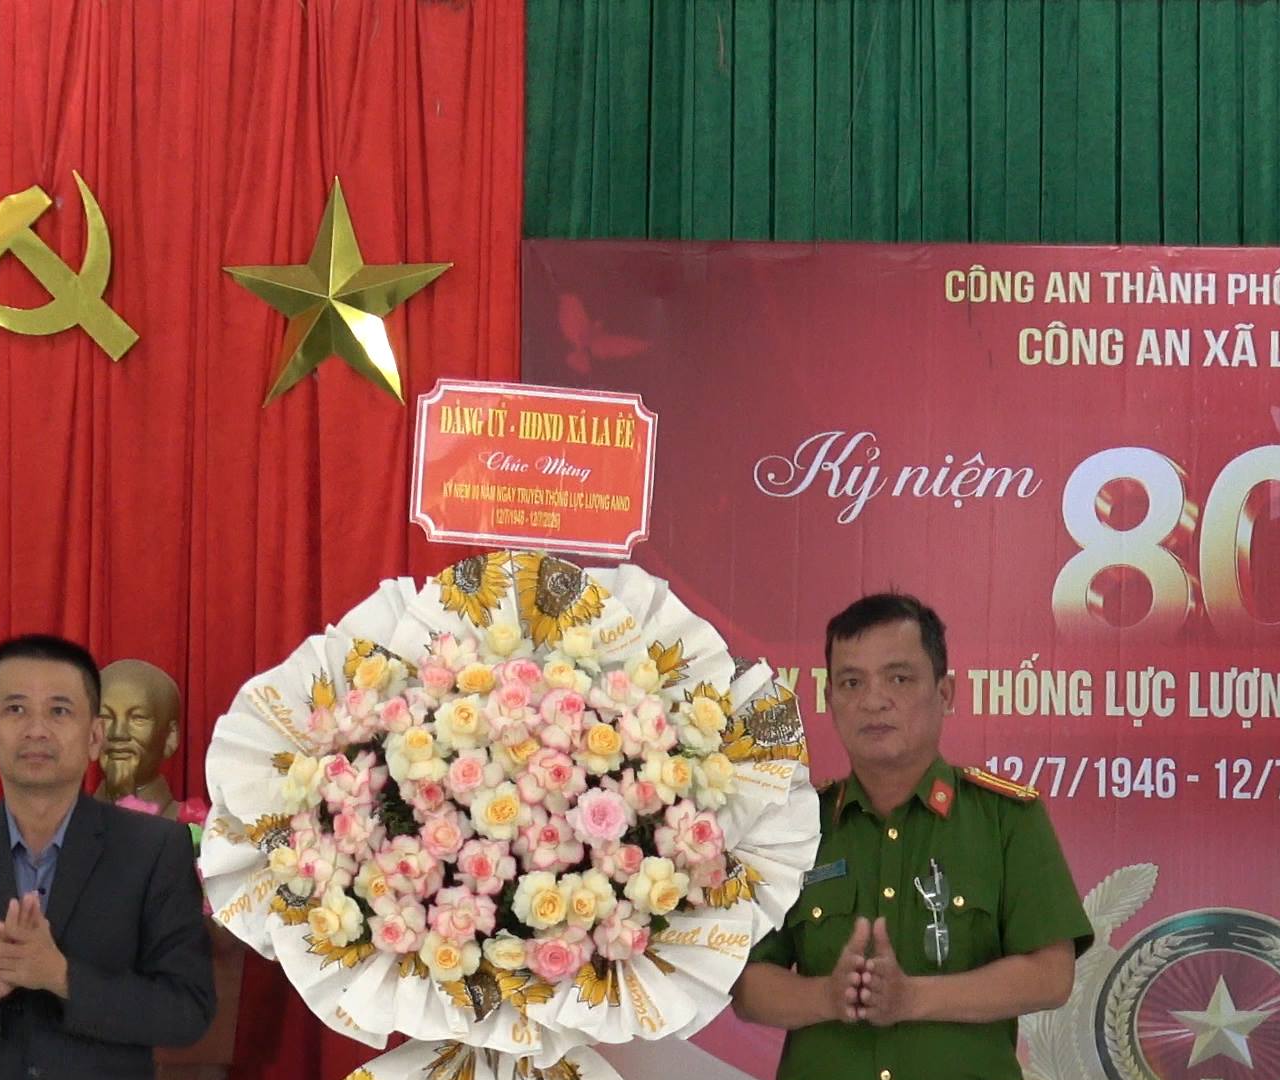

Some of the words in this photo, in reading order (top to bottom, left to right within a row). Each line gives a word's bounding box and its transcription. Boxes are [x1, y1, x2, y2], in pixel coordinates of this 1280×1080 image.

[945, 264, 1035, 303] CÔNG
[1044, 271, 1091, 304] AN
[1100, 265, 1217, 305] THÀNH
[1018, 320, 1124, 366] CÔNG
[1136, 328, 1190, 367] AN
[1202, 323, 1258, 369] XÃ
[591, 416, 611, 447] LA
[479, 451, 529, 473] Chúc
[753, 431, 888, 525] Kỷ
[891, 451, 1043, 509] niệm
[968, 653, 1093, 717] THỐNG
[1105, 666, 1176, 729] LỰC
[707, 922, 751, 948] love
